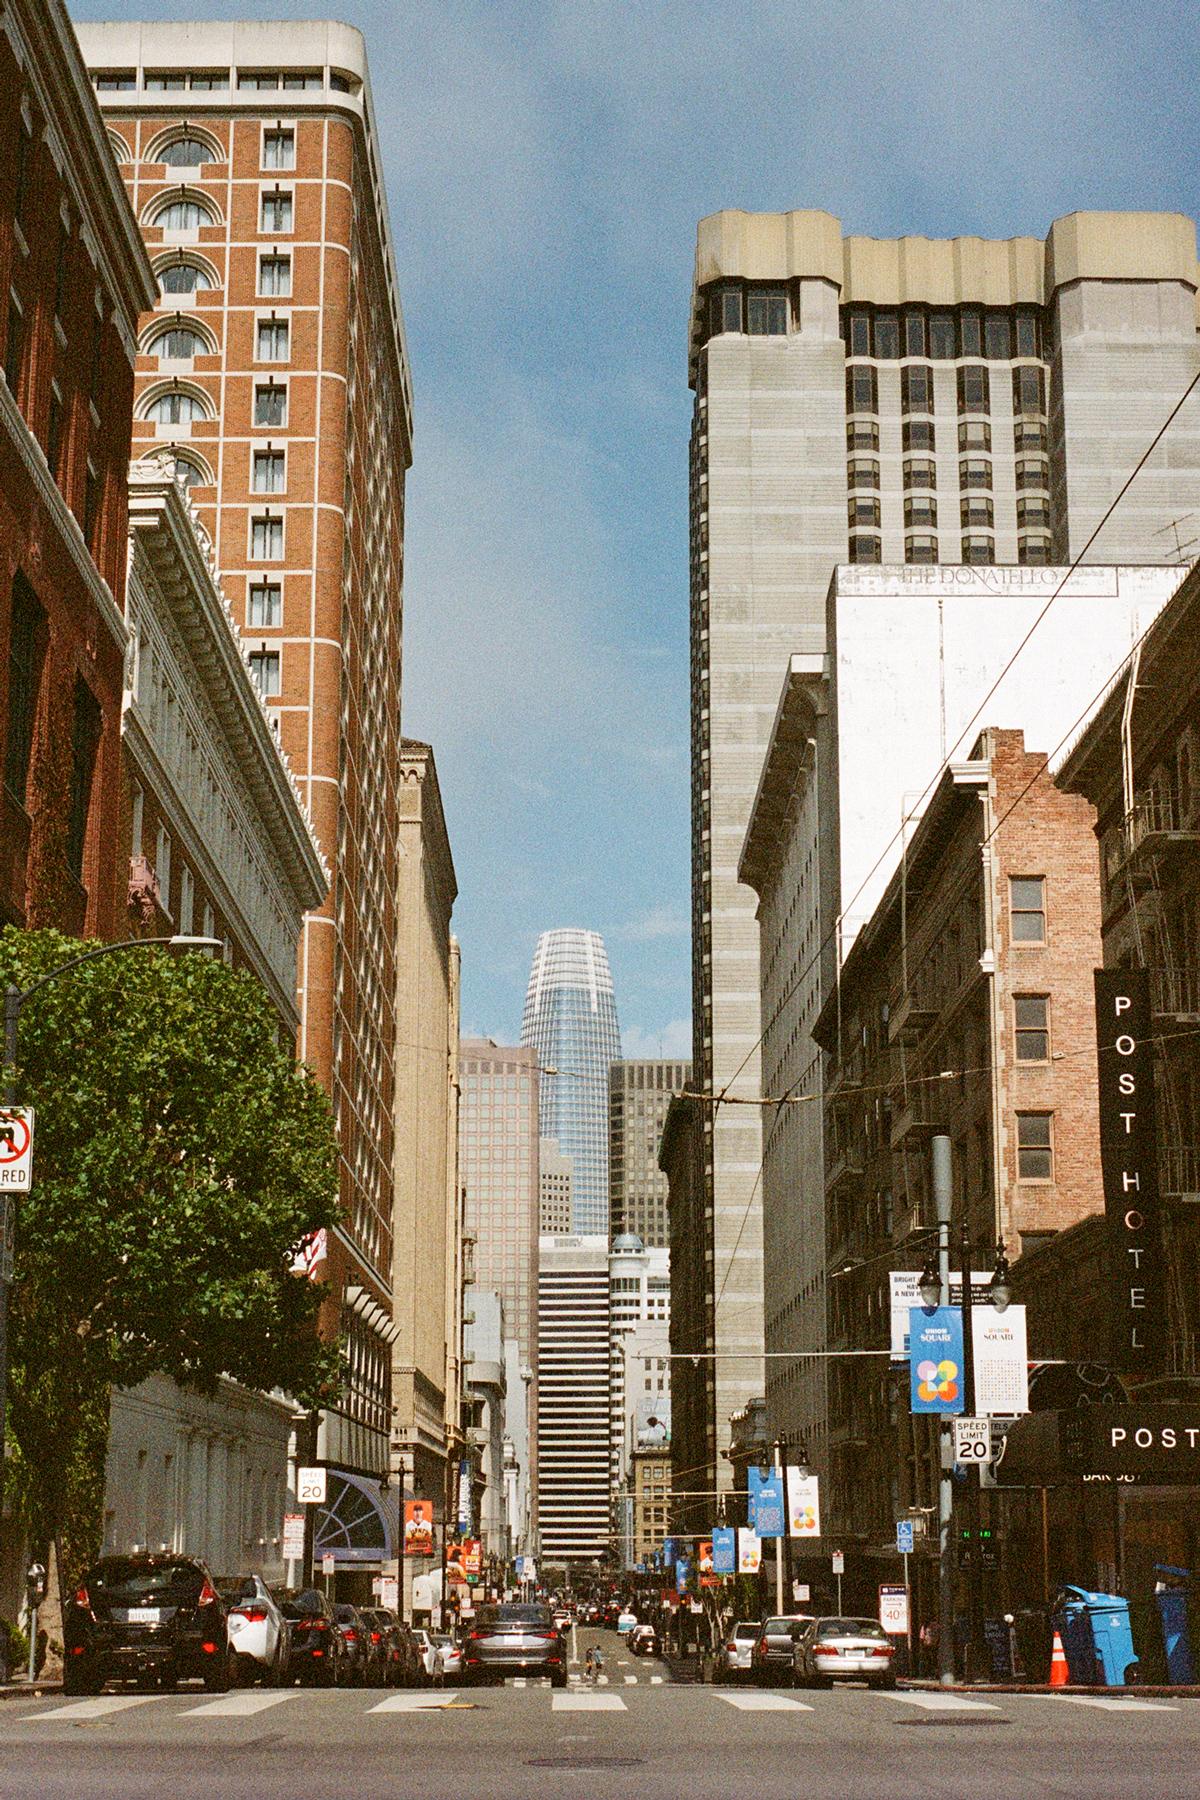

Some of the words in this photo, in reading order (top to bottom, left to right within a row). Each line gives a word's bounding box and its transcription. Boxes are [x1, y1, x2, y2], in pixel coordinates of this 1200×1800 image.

[901, 567, 936, 584] THE
[940, 566, 1058, 593] DONATELLO
[1114, 996, 1136, 1134] POST
[2, 1169, 26, 1182] RED
[1122, 1171, 1146, 1348] HOTEL
[920, 1334, 952, 1343] SQUARE
[983, 1333, 1014, 1341] SQUARE
[957, 1422, 988, 1431] SPEED
[960, 1432, 984, 1440] LIMIT
[1111, 1428, 1200, 1448] POST
[959, 1441, 987, 1458] 20
[302, 1485, 322, 1498] 20
